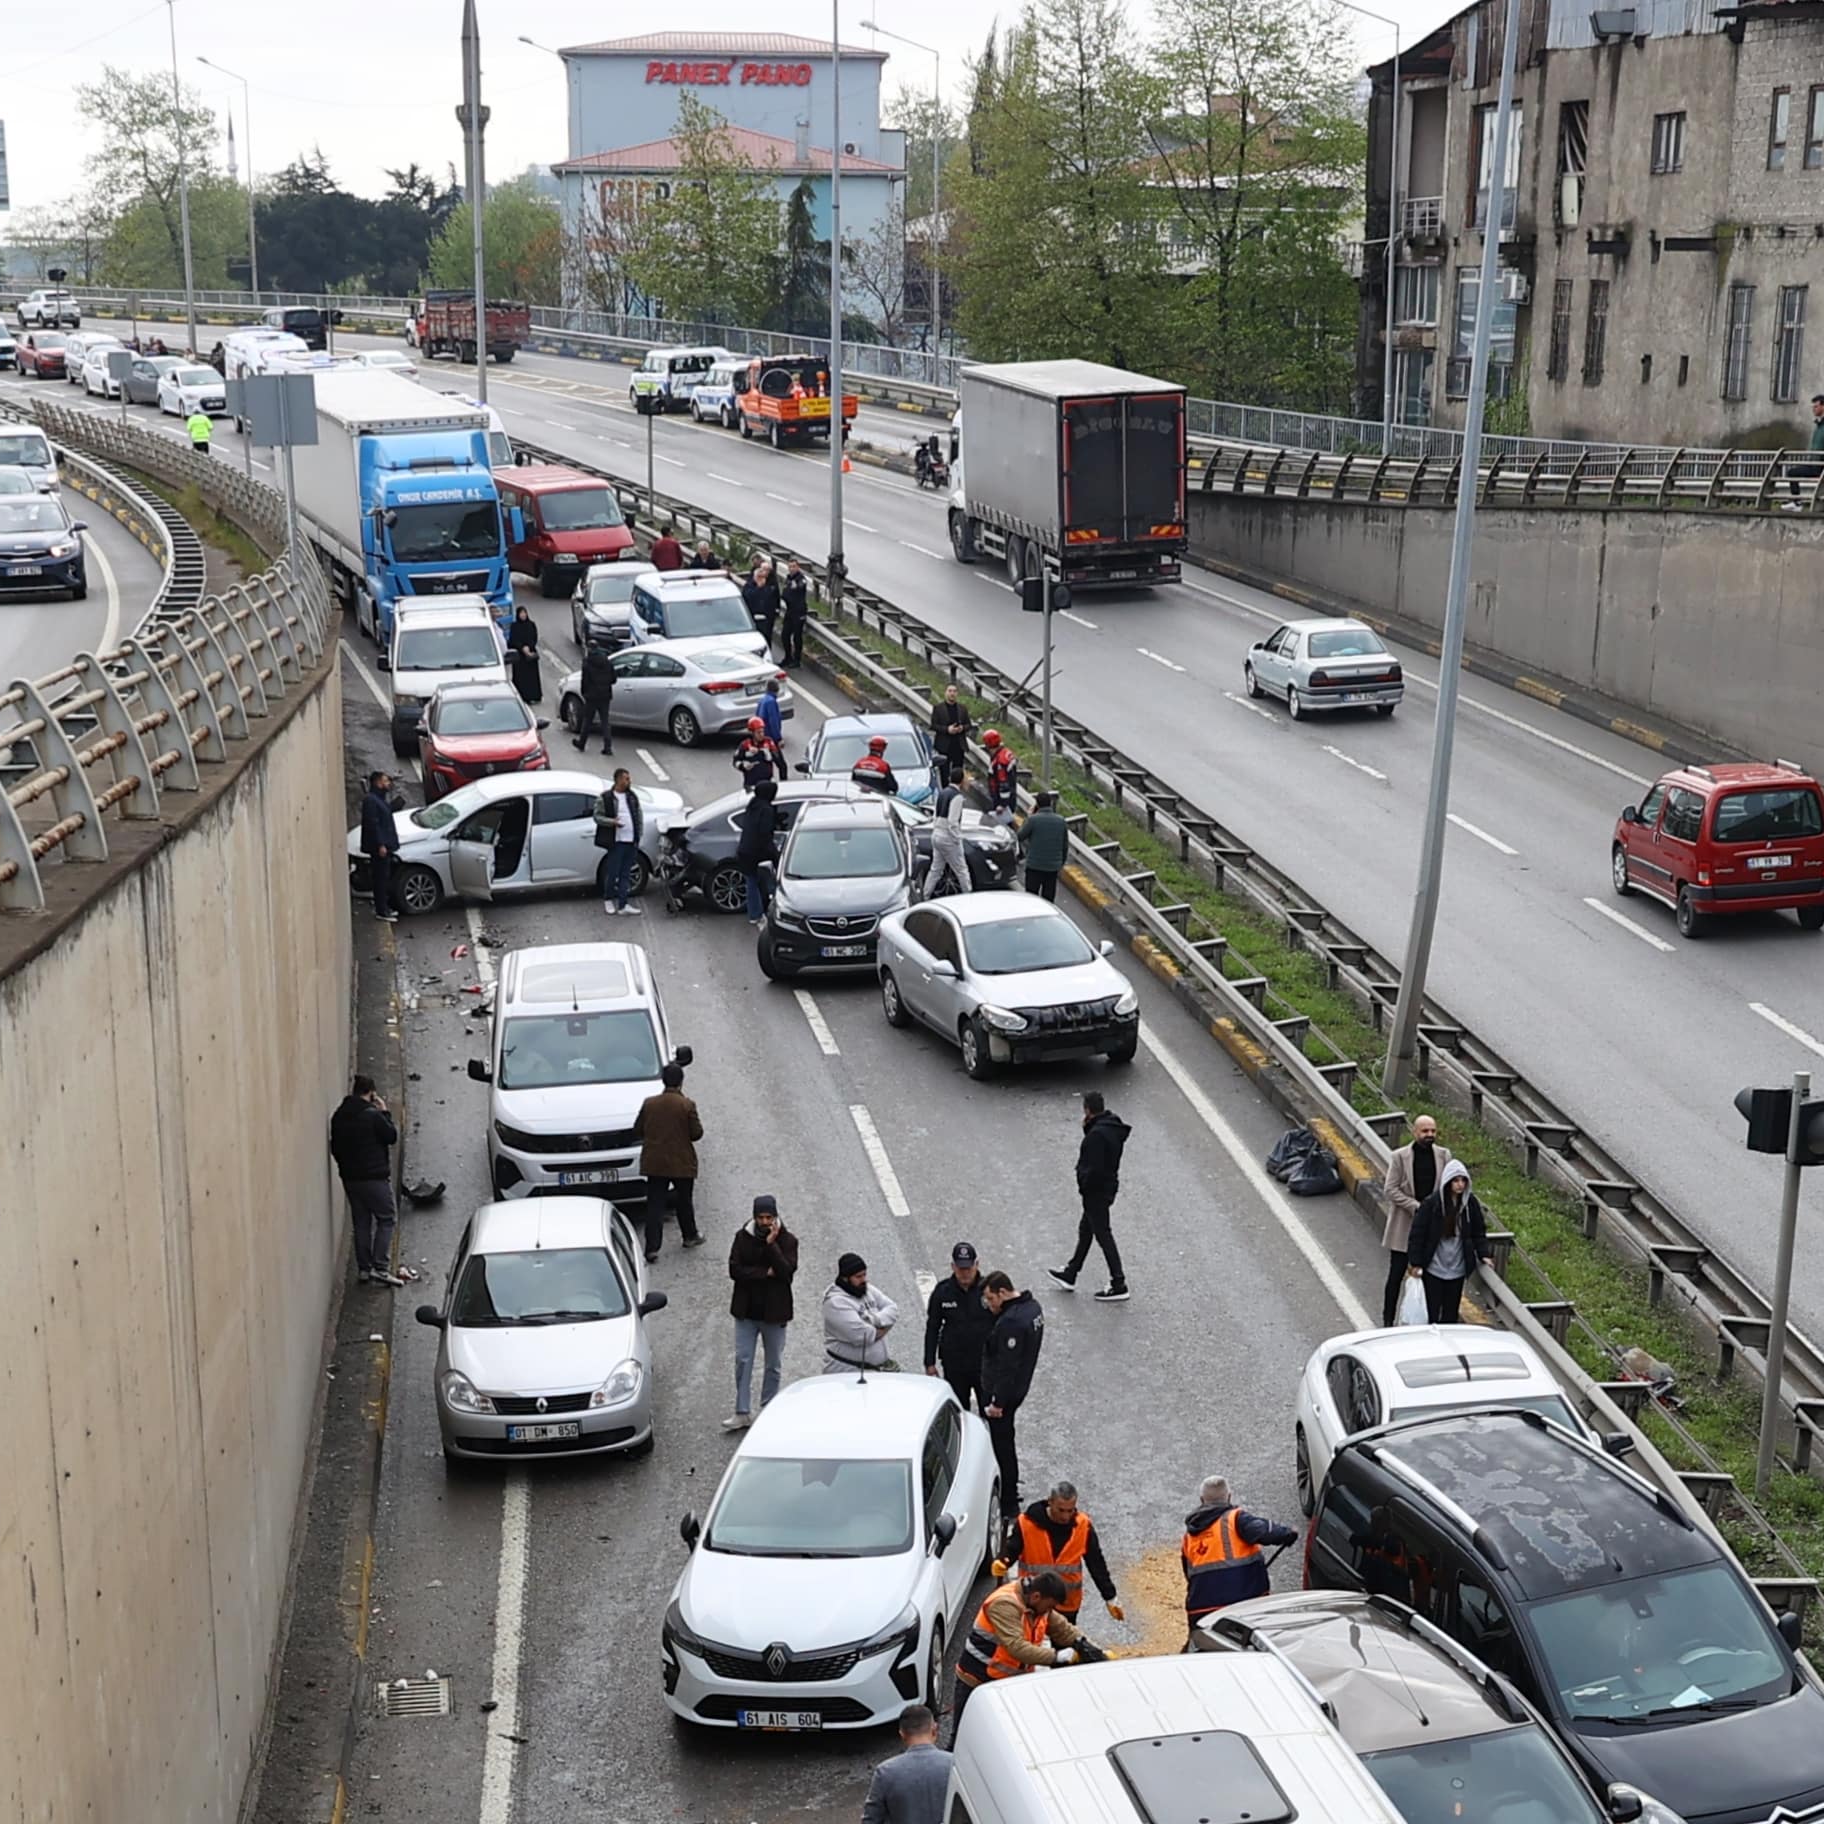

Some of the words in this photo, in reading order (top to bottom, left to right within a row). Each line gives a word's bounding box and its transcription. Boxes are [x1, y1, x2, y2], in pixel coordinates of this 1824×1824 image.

[645, 61, 733, 85] PANEX
[740, 63, 812, 86] PANO
[433, 583, 468, 593] MAN
[565, 1173, 575, 1185] 61
[515, 1428, 526, 1439] 01
[534, 1426, 549, 1438] DM
[746, 1712, 760, 1725] 61
[768, 1712, 788, 1726] AIS
[798, 1713, 819, 1727] 604
